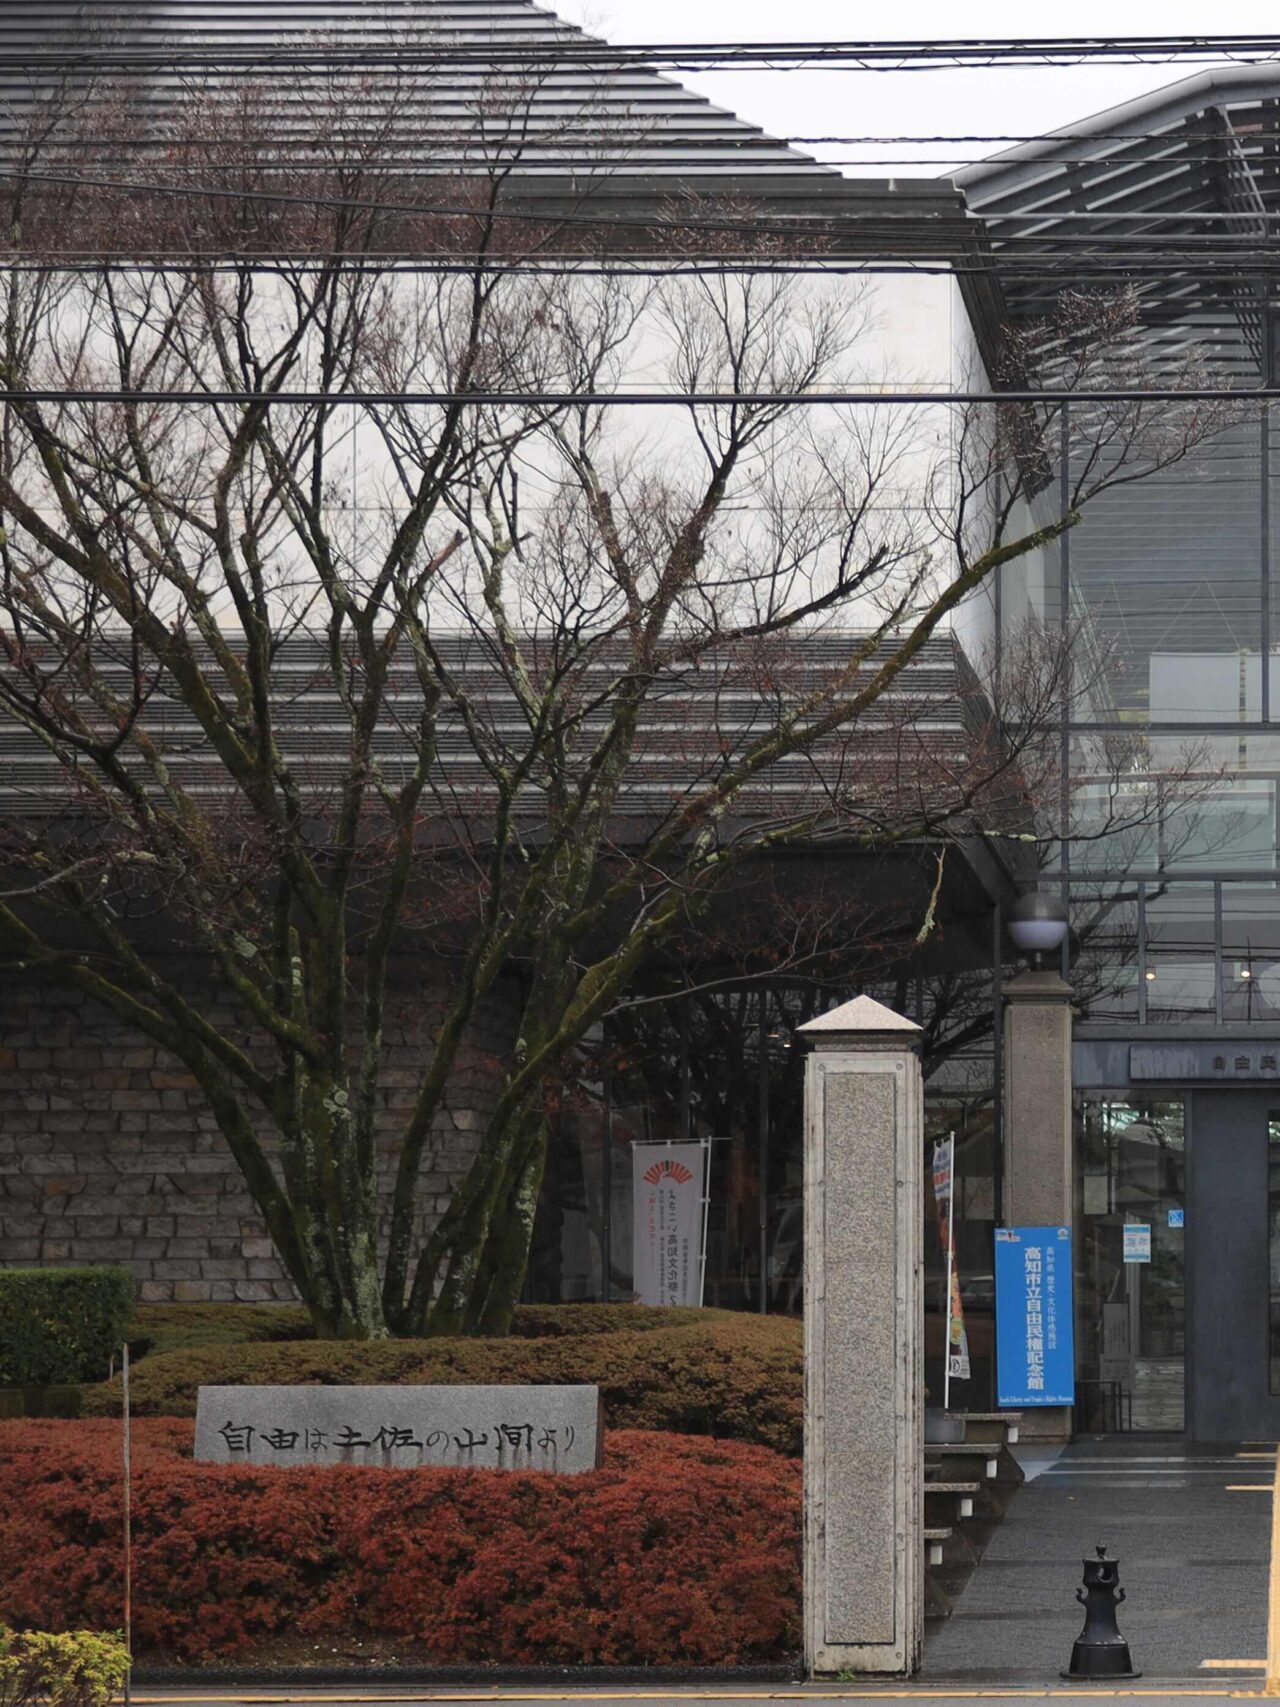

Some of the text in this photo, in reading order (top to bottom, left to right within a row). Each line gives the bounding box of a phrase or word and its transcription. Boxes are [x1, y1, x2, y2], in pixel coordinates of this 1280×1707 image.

[1024, 1246, 1045, 1390] 高知市立自由民権記念館
[218, 1420, 575, 1453] 自由は土佐の山間より
